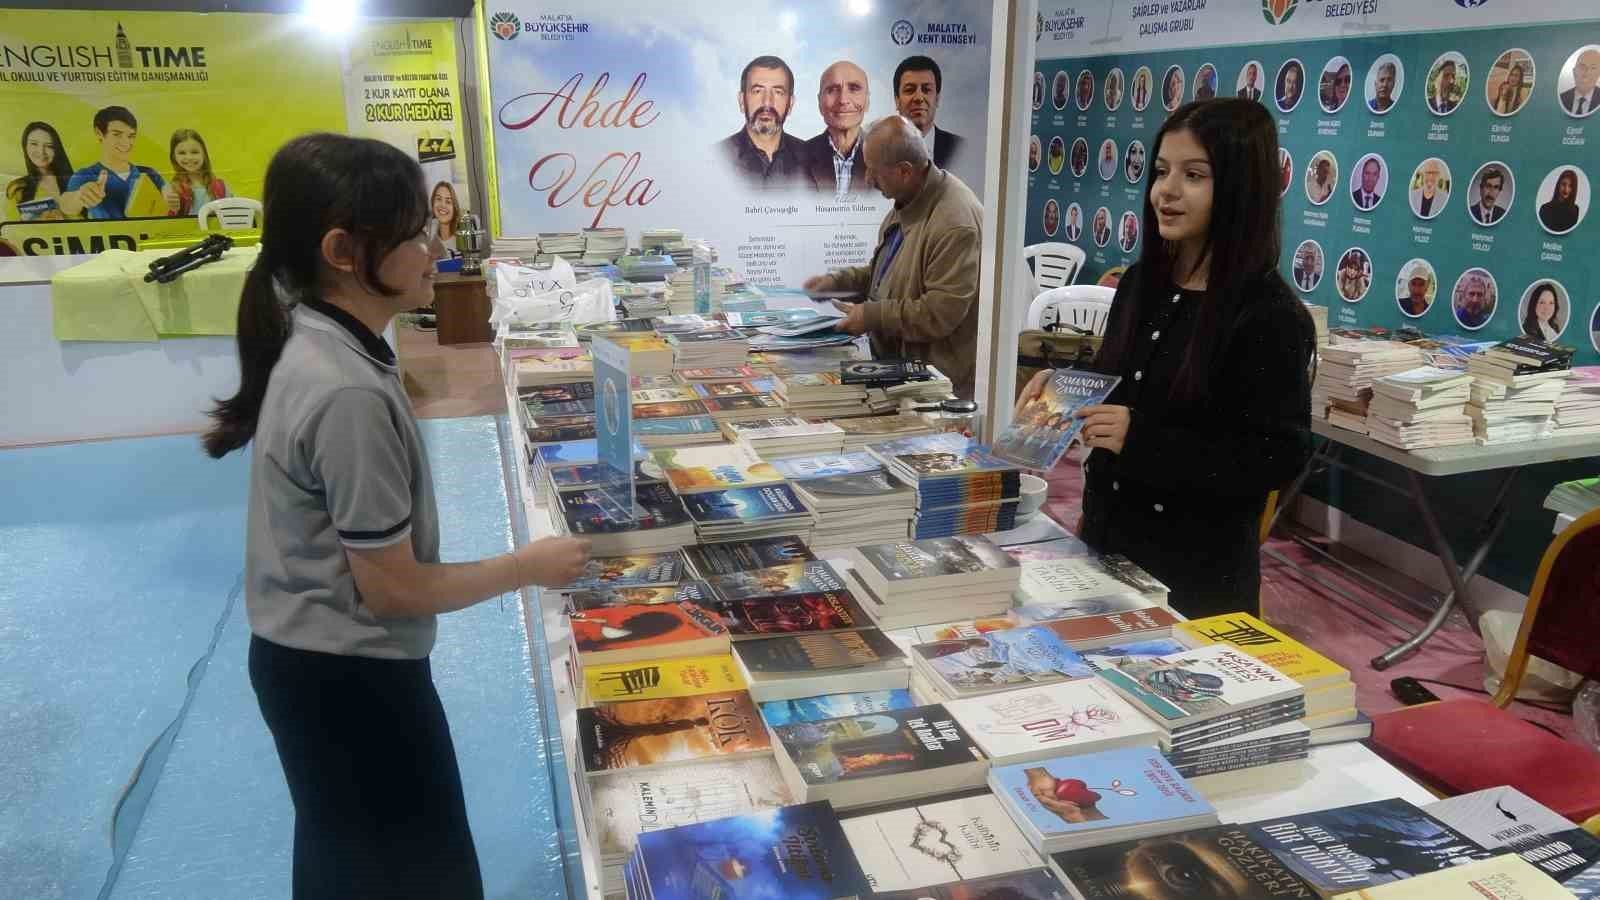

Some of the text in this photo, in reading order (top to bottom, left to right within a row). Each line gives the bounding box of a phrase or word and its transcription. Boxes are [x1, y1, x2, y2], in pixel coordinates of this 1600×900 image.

[540, 14, 574, 22] MALATYA
[1139, 19, 1195, 36] ÇALIŞMA GRUBU
[927, 23, 968, 33] MALATYA
[412, 39, 433, 49] TIME
[917, 32, 977, 45] KENT KONSEYİ
[0, 45, 207, 68] NGLISH TIME
[11, 71, 45, 82] OKULU
[47, 71, 61, 82] VE
[107, 70, 140, 82] EĞİTİM
[141, 71, 209, 83] DANIŞMANLIĞI
[365, 87, 450, 99] 2 KUR KAYIT OLANA
[499, 71, 662, 131] Ahde
[365, 99, 454, 121] 2 KUR HEDİYE!
[528, 151, 663, 229] Vefa
[1055, 375, 1108, 389] ZAMANDAN
[706, 697, 751, 747] KÖK
[1261, 822, 1370, 884] BİR DÜNYA
[1301, 825, 1377, 872] HER İNSAN
[1228, 830, 1311, 898] HAKİKATİN
